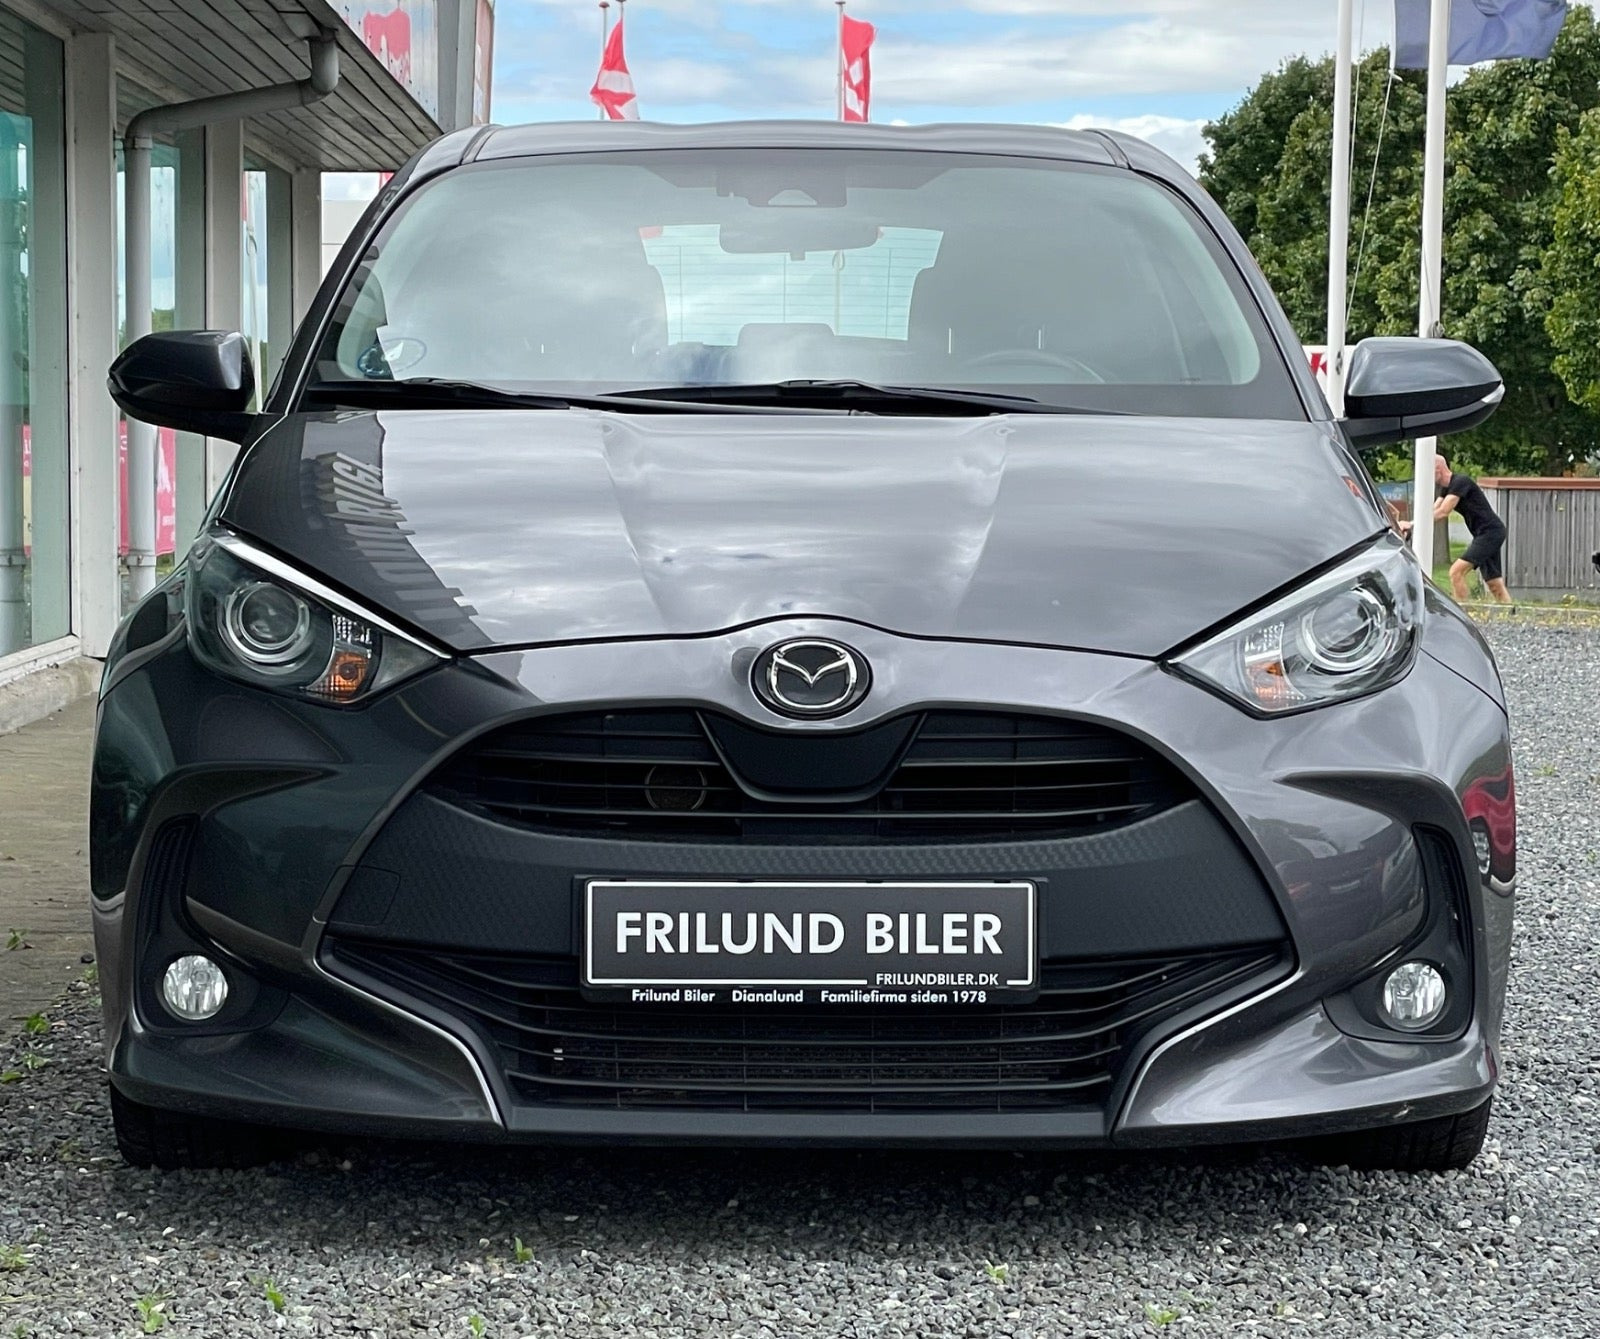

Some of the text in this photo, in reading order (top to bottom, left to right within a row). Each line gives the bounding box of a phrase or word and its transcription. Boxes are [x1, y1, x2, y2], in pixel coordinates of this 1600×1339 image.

[616, 912, 1003, 955] FRILUND BILER
[875, 973, 999, 986] FRILUNDBILER.DK
[631, 988, 987, 1003] Frilund Biler Dianalund Familiefirma siden 1978
